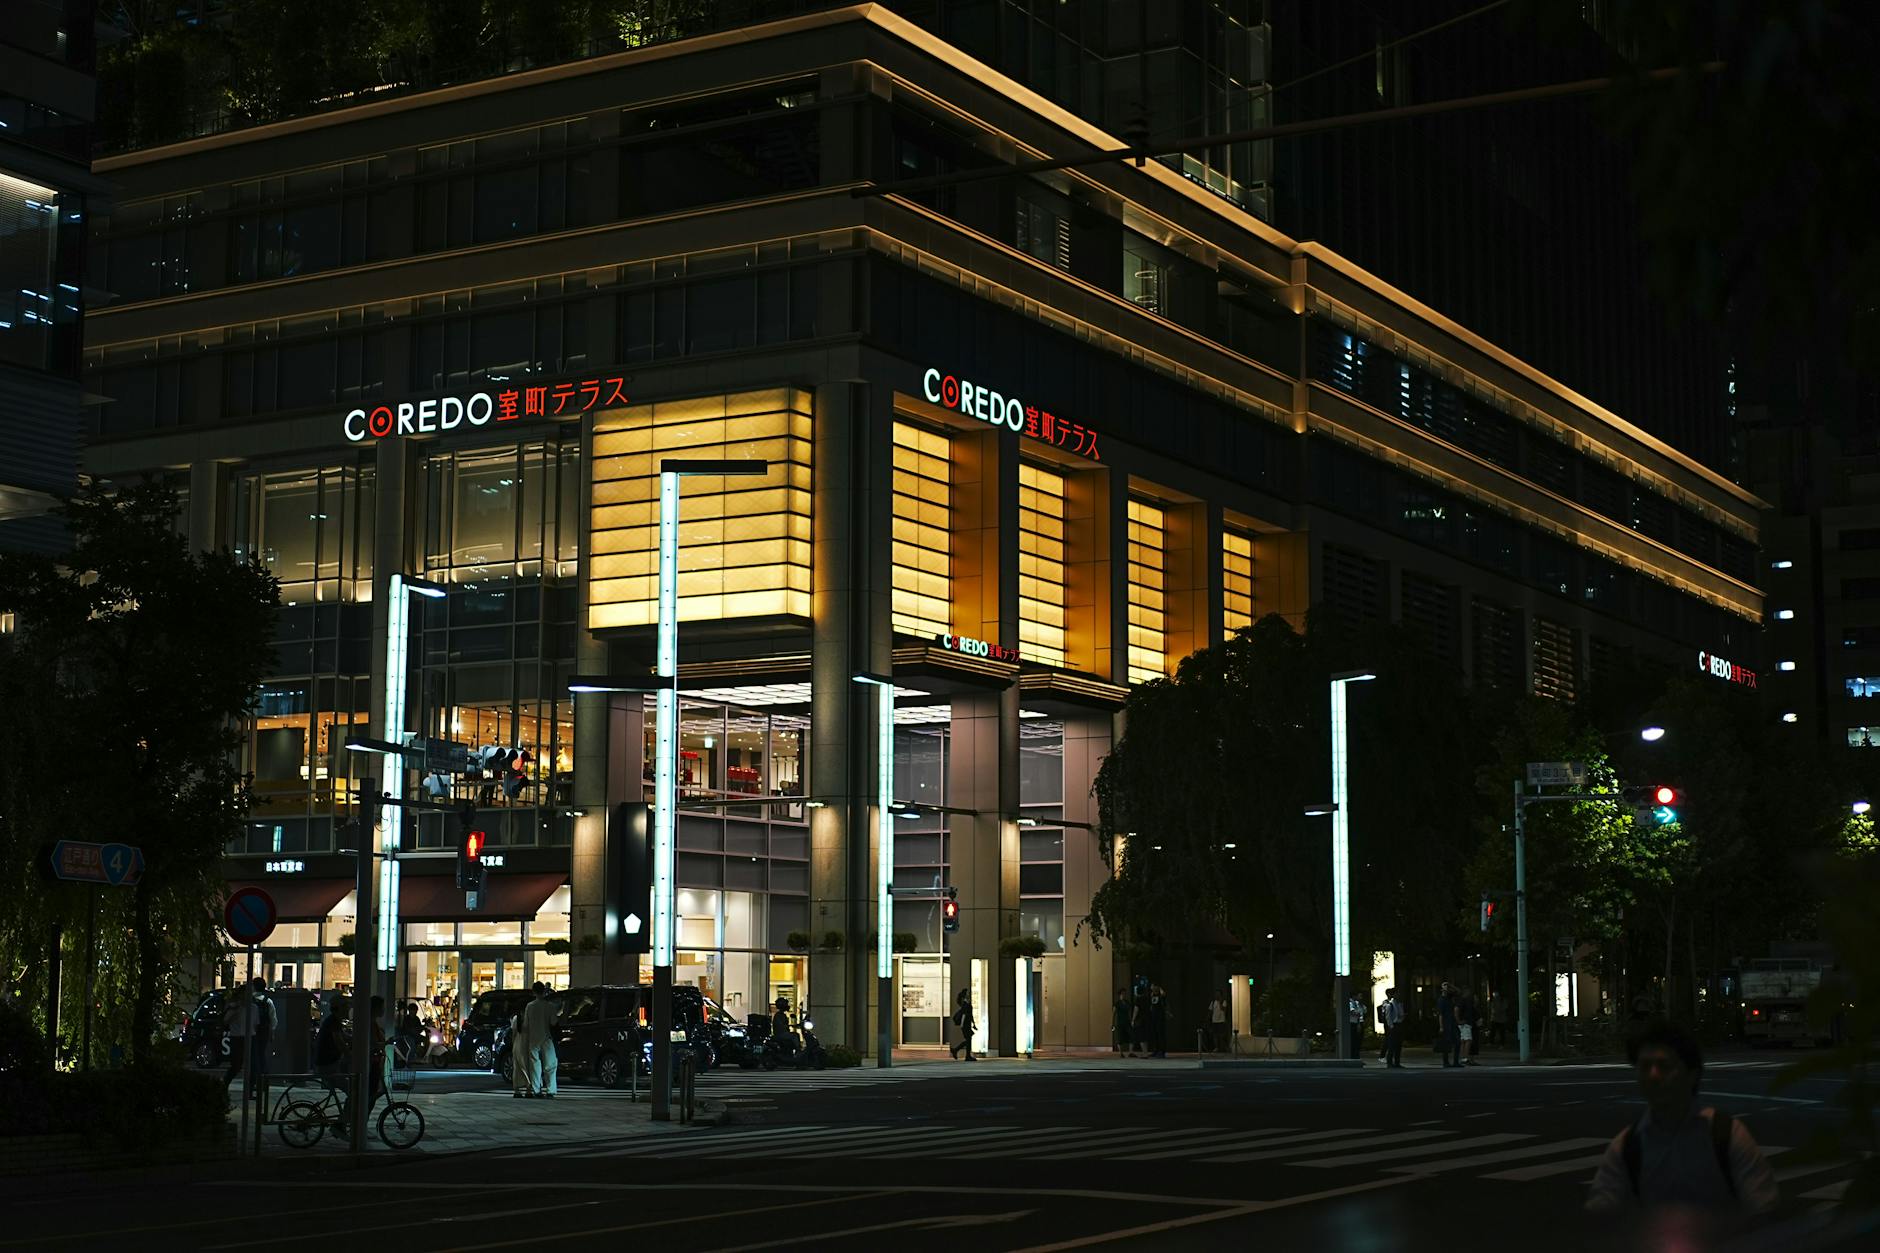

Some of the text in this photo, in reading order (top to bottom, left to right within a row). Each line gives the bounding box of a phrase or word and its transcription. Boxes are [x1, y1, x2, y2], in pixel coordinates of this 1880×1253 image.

[344, 377, 628, 441] COREDO 室町テラス
[924, 368, 1100, 461] COREDO 室町テラス
[943, 634, 988, 657] COREDO
[1699, 651, 1731, 681] COREDO
[111, 849, 123, 873] 4
